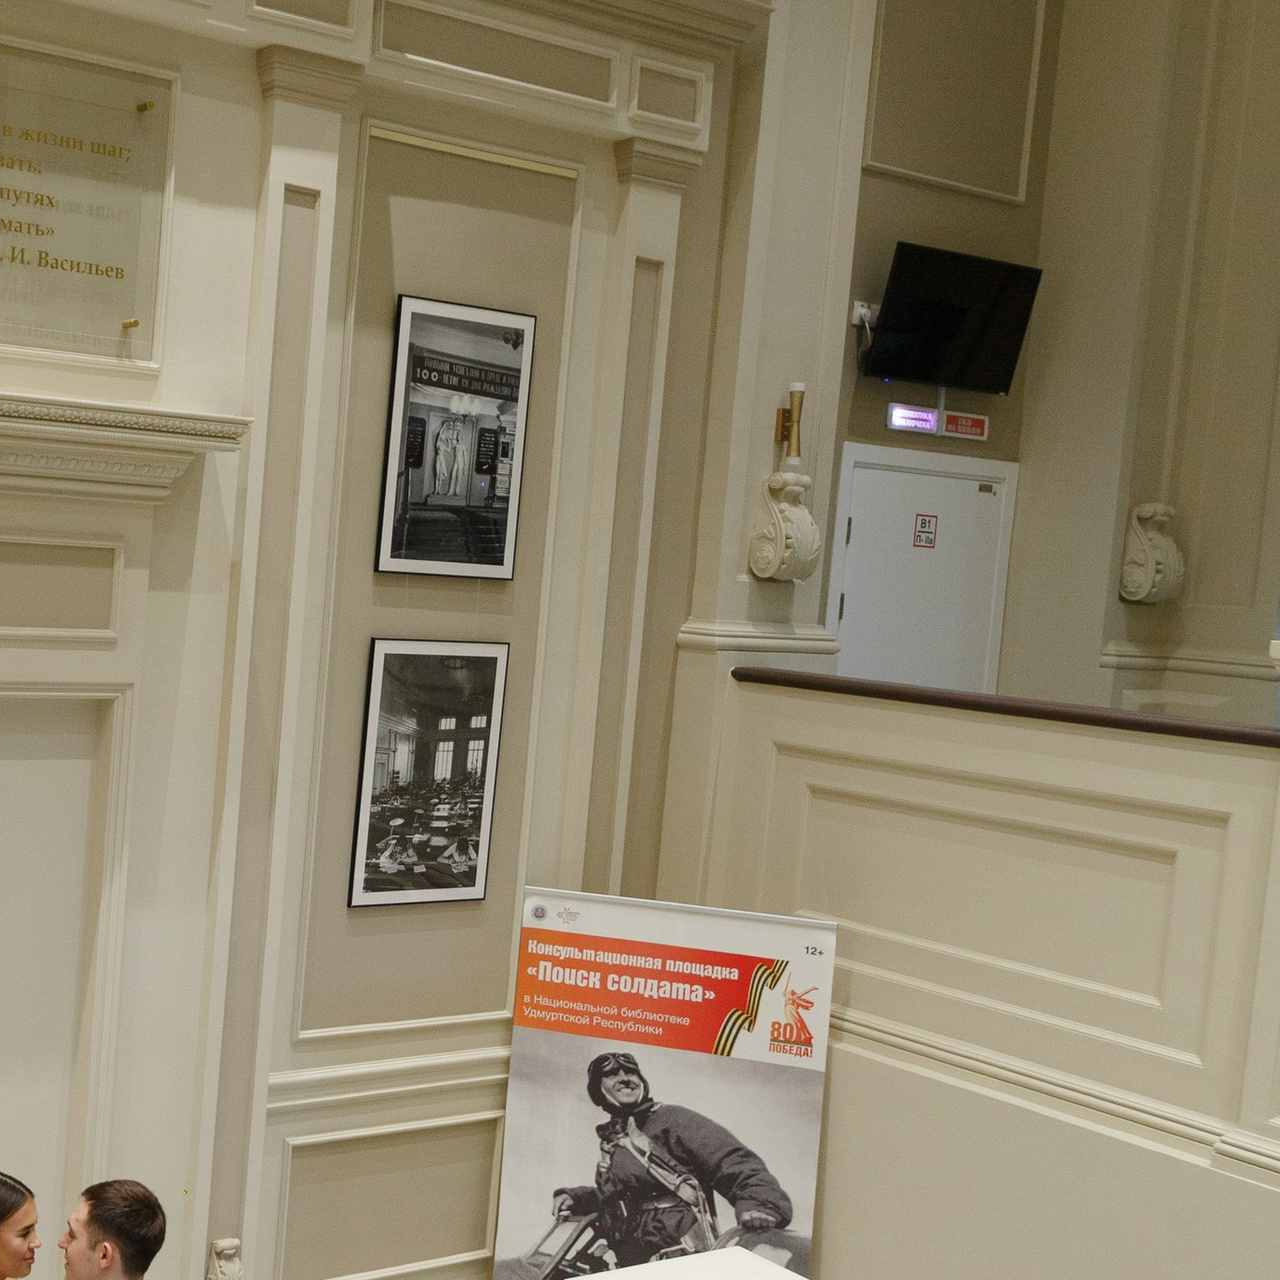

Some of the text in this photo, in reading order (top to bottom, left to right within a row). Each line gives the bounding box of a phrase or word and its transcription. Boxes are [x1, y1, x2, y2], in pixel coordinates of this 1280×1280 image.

[2, 123, 13, 138] в
[19, 128, 84, 152] жизни
[90, 141, 131, 163] шаг;
[0, 217, 55, 237] мать»
[10, 245, 31, 266] И.
[37, 249, 124, 280] Васильев
[527, 939, 739, 980] Консультационная площадка
[805, 946, 824, 956] 12+
[526, 960, 716, 1002] «Поиск солдата»
[523, 994, 690, 1026] в Национальной библиотеке
[523, 1006, 663, 1035] Удмуртской Республики
[770, 1021, 795, 1042] 80
[768, 1042, 813, 1058] ПОБЕДА!
